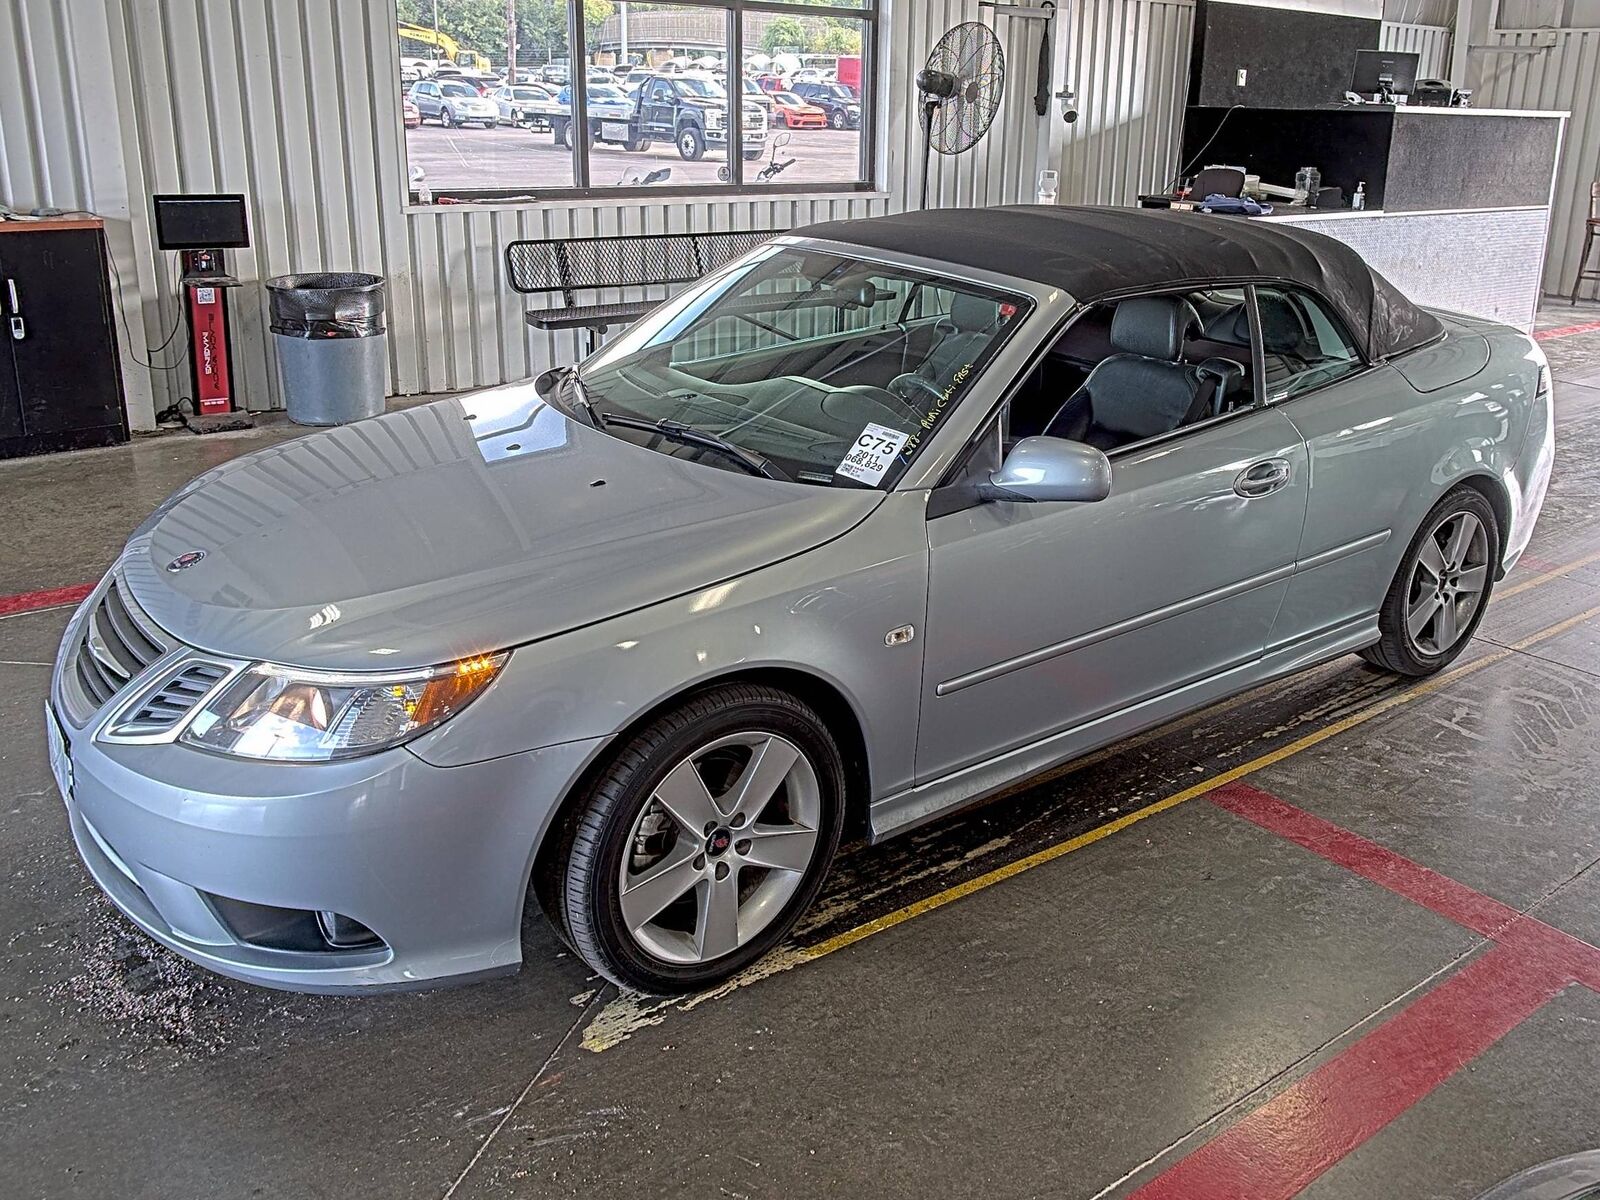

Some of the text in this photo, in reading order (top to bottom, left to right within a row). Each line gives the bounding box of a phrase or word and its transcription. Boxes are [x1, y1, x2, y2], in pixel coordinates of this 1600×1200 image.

[202, 331, 212, 375] IMAGING
[858, 434, 897, 455] C75
[845, 453, 884, 472] 068,829
[856, 450, 880, 463] 2011
